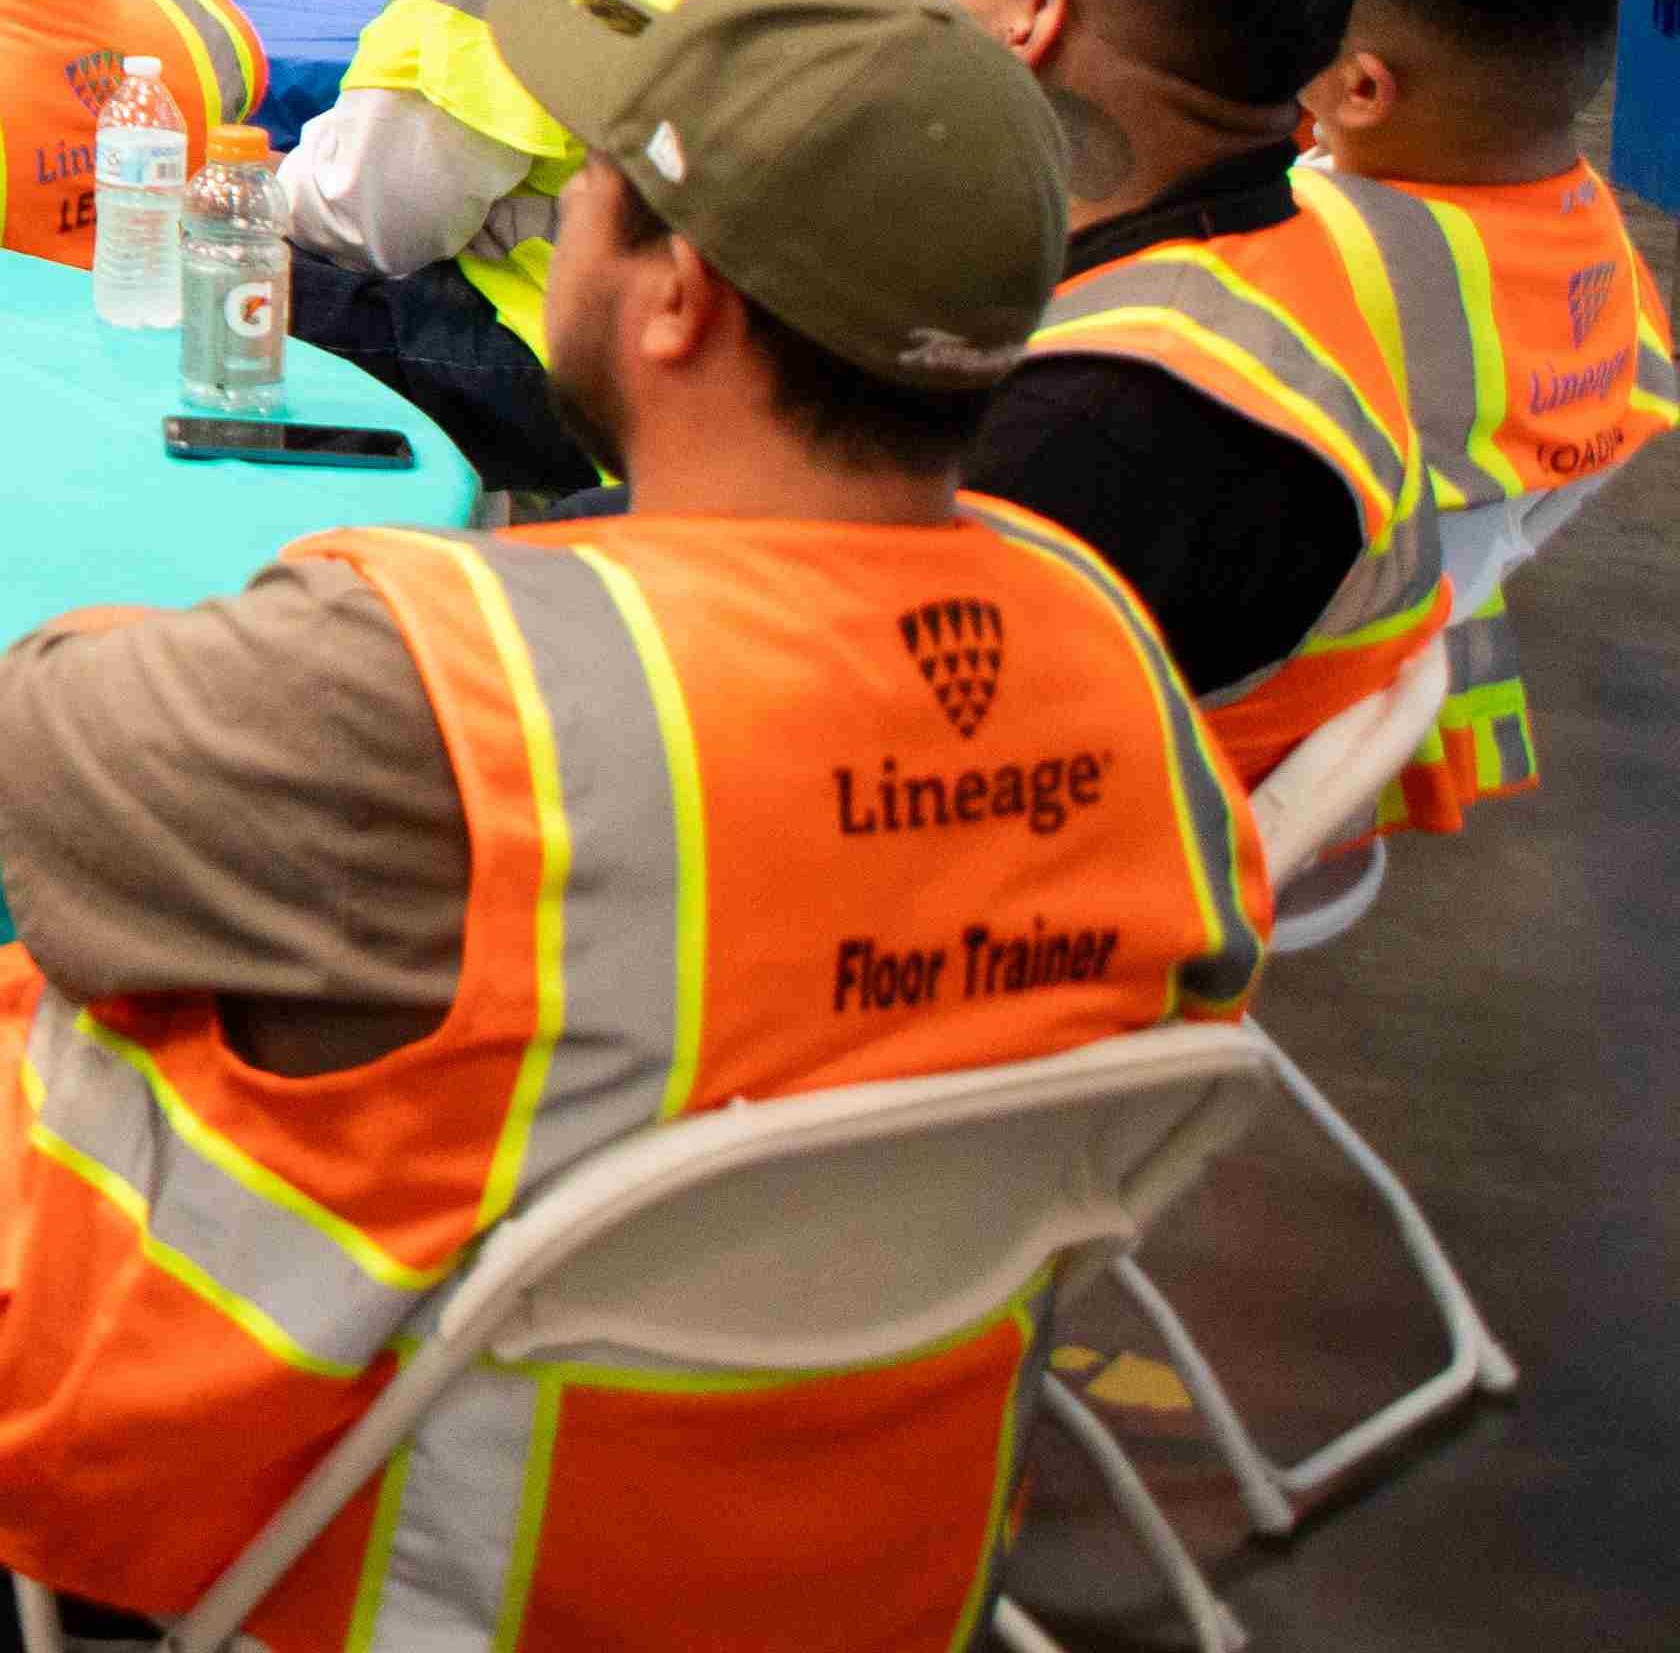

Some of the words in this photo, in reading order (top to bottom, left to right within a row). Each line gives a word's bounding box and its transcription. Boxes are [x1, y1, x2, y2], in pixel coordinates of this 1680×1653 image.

[834, 756, 1104, 840] Lineage
[834, 934, 948, 1012] Floor
[963, 922, 1119, 999] Trainer
